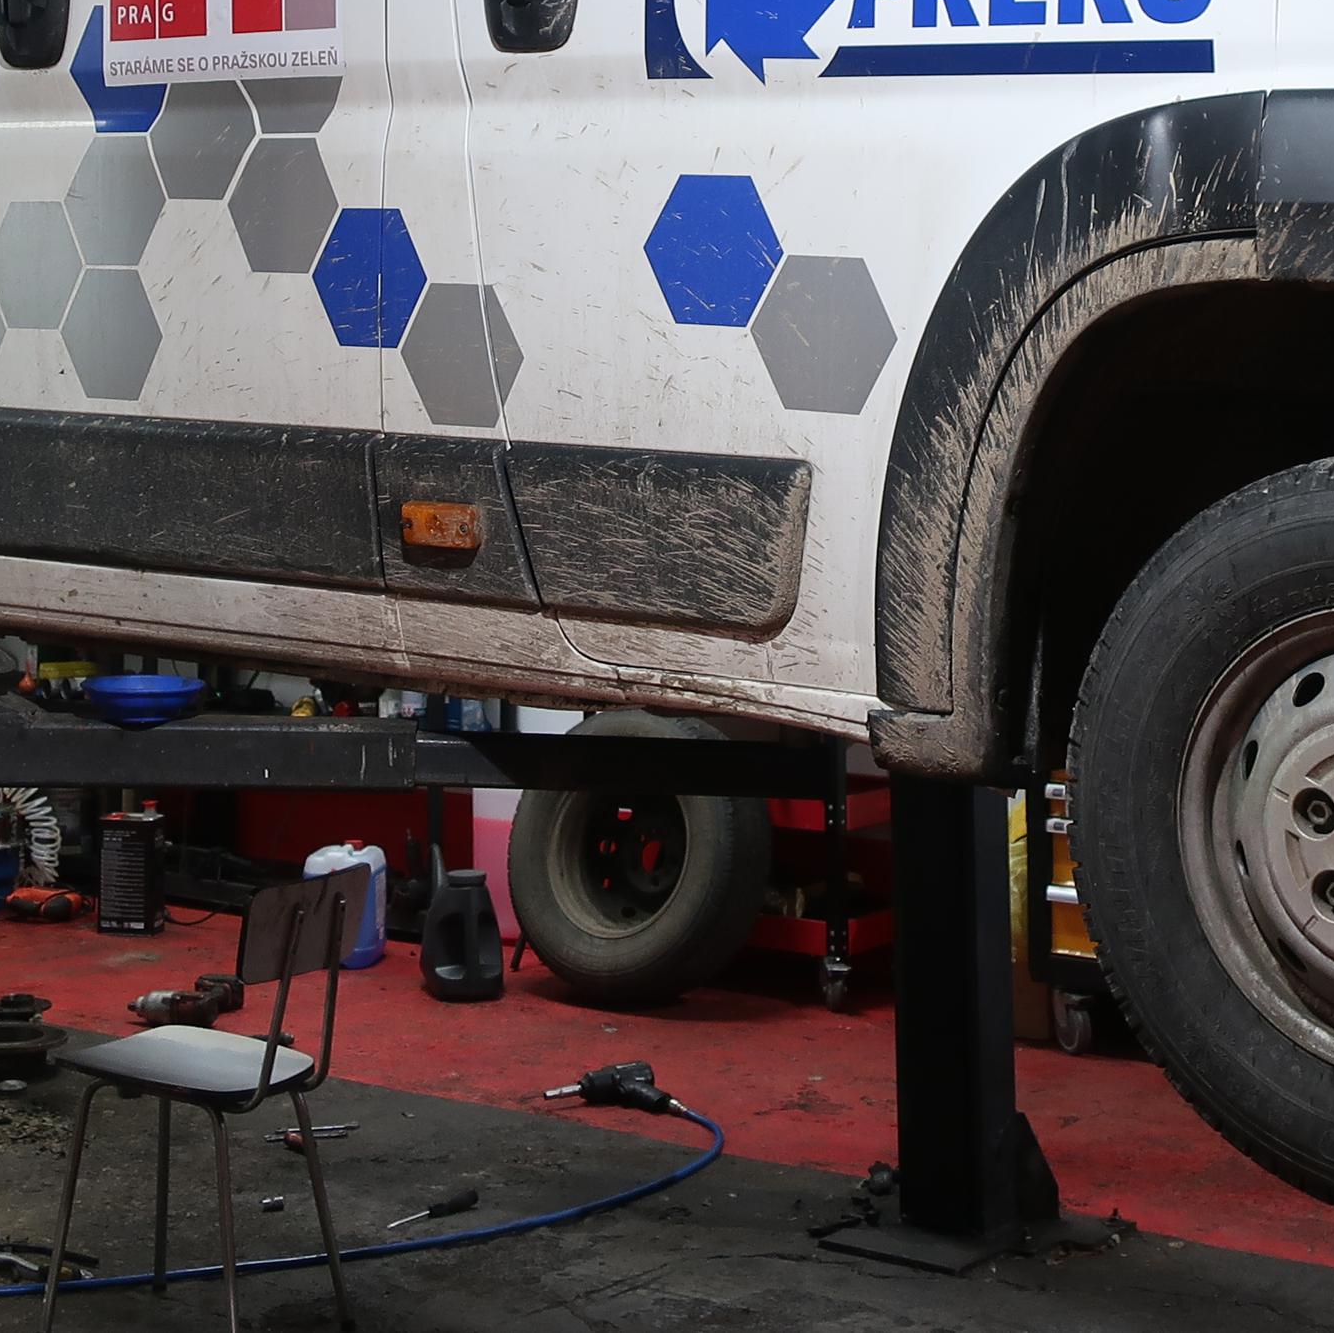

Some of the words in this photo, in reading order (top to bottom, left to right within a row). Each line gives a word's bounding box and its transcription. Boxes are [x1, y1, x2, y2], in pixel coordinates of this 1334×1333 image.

[110, 56, 173, 76] STARÁME
[177, 57, 195, 72] SE
[198, 56, 209, 71] O
[212, 51, 288, 71] PRAŽSKOU
[291, 46, 338, 67] ZELEŇ
